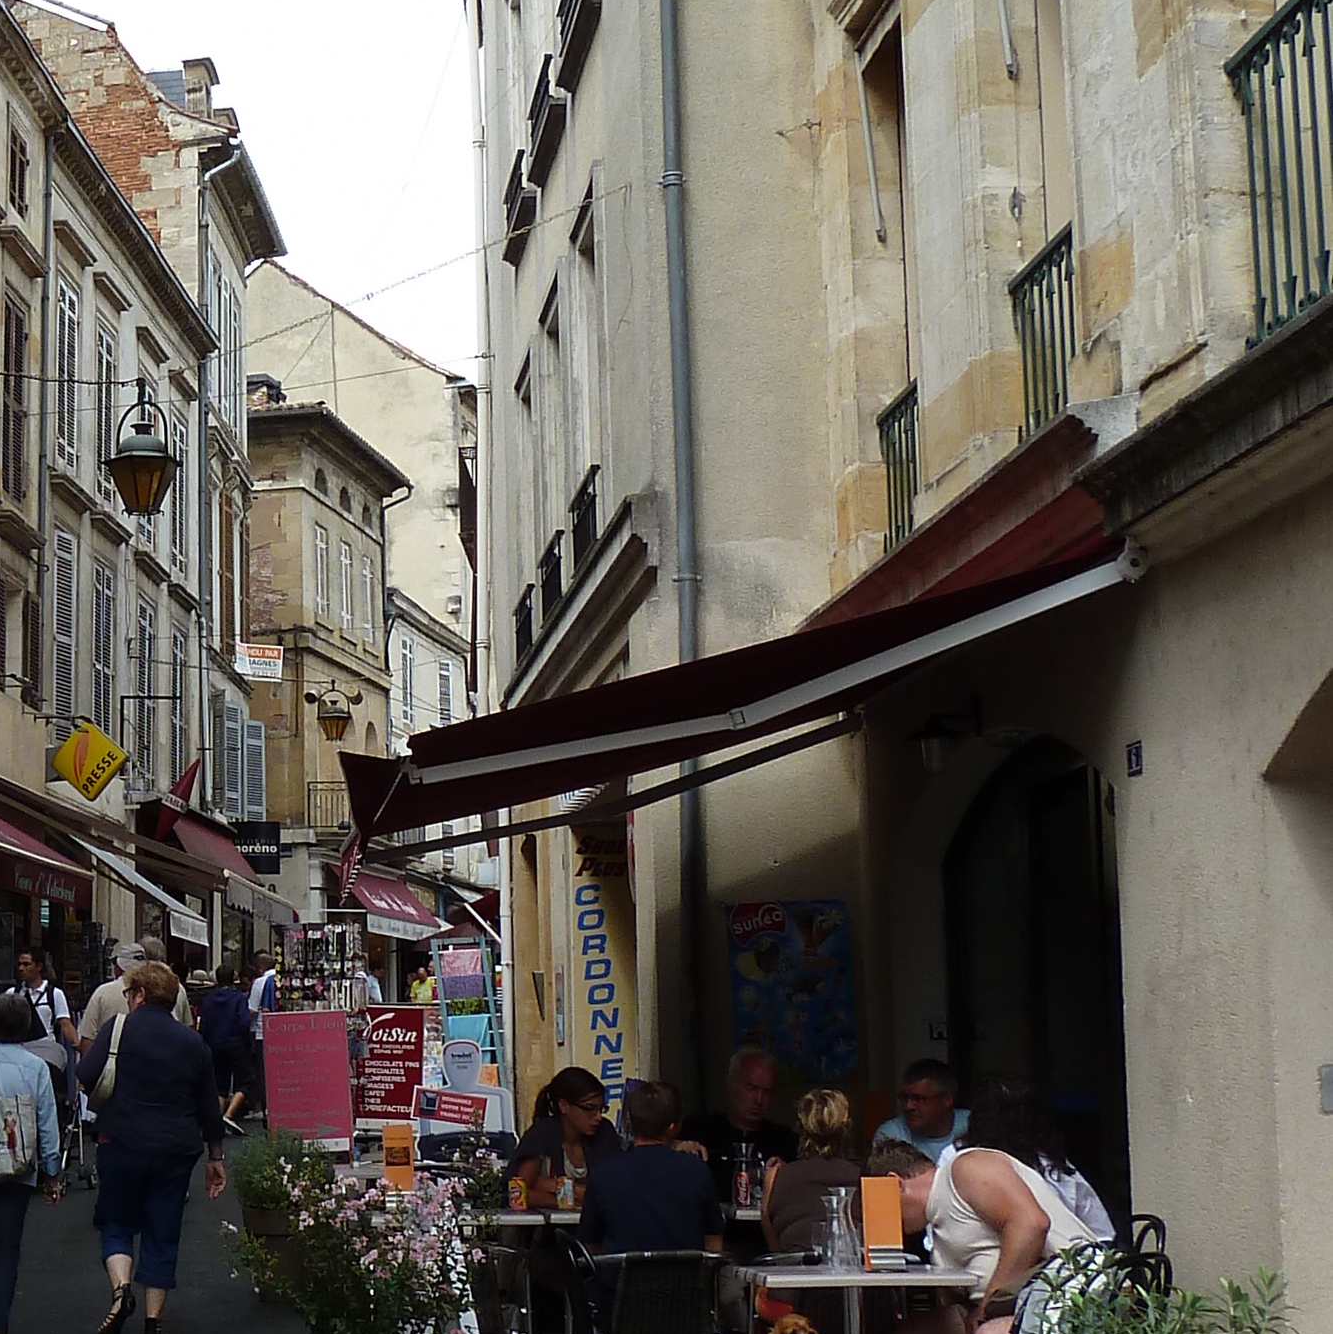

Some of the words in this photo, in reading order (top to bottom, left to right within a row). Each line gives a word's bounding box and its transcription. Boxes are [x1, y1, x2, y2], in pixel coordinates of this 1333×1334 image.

[81, 750, 118, 795] PRESSE
[364, 1059, 403, 1067] CHOCOLATS
[364, 1067, 405, 1075] SPECIALITES
